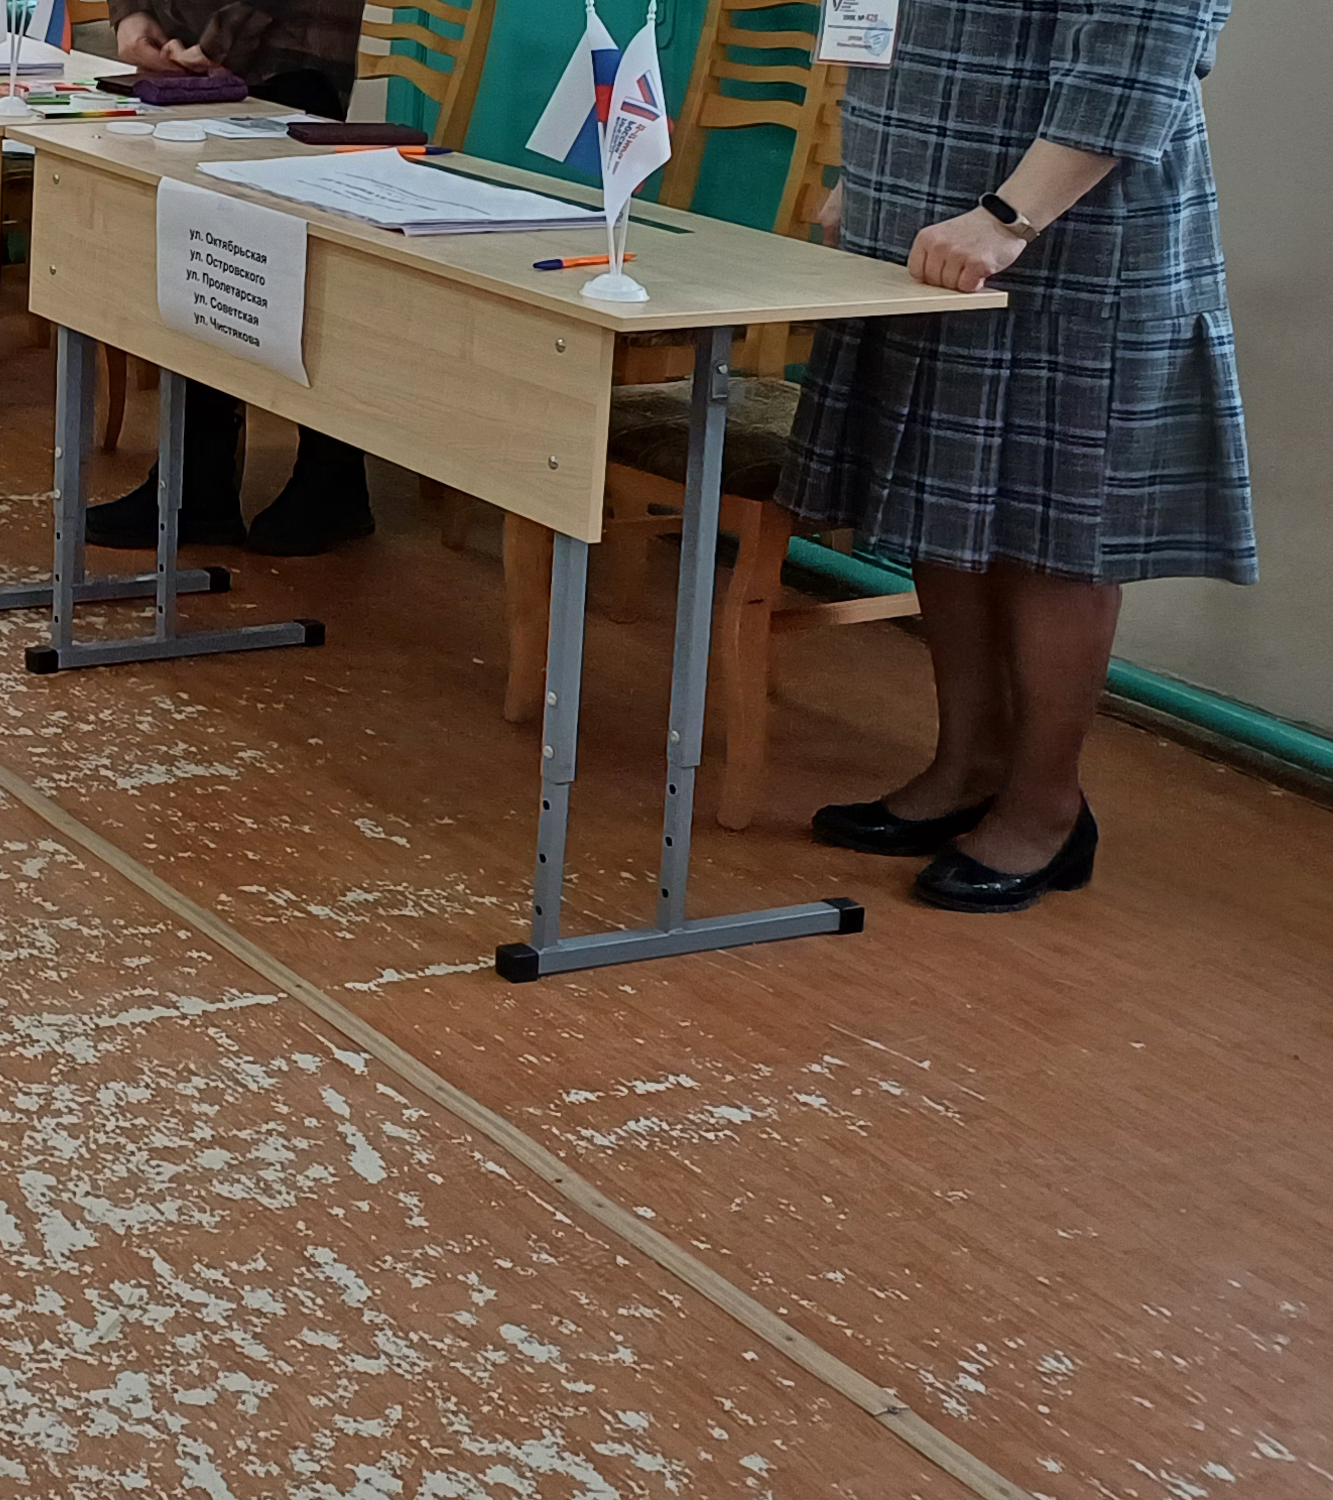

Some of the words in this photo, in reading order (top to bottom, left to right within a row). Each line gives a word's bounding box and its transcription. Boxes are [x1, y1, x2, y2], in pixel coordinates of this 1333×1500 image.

[189, 228, 203, 242] ул.
[205, 232, 267, 265] Октябрьская
[189, 248, 203, 262] ул.
[205, 254, 266, 286] Островского
[186, 268, 201, 282] ул.
[202, 273, 268, 309] Пролетарская
[193, 291, 208, 306] ул.
[210, 296, 259, 326] Советская
[193, 312, 208, 326] ул.
[209, 318, 261, 348] Чистякова
